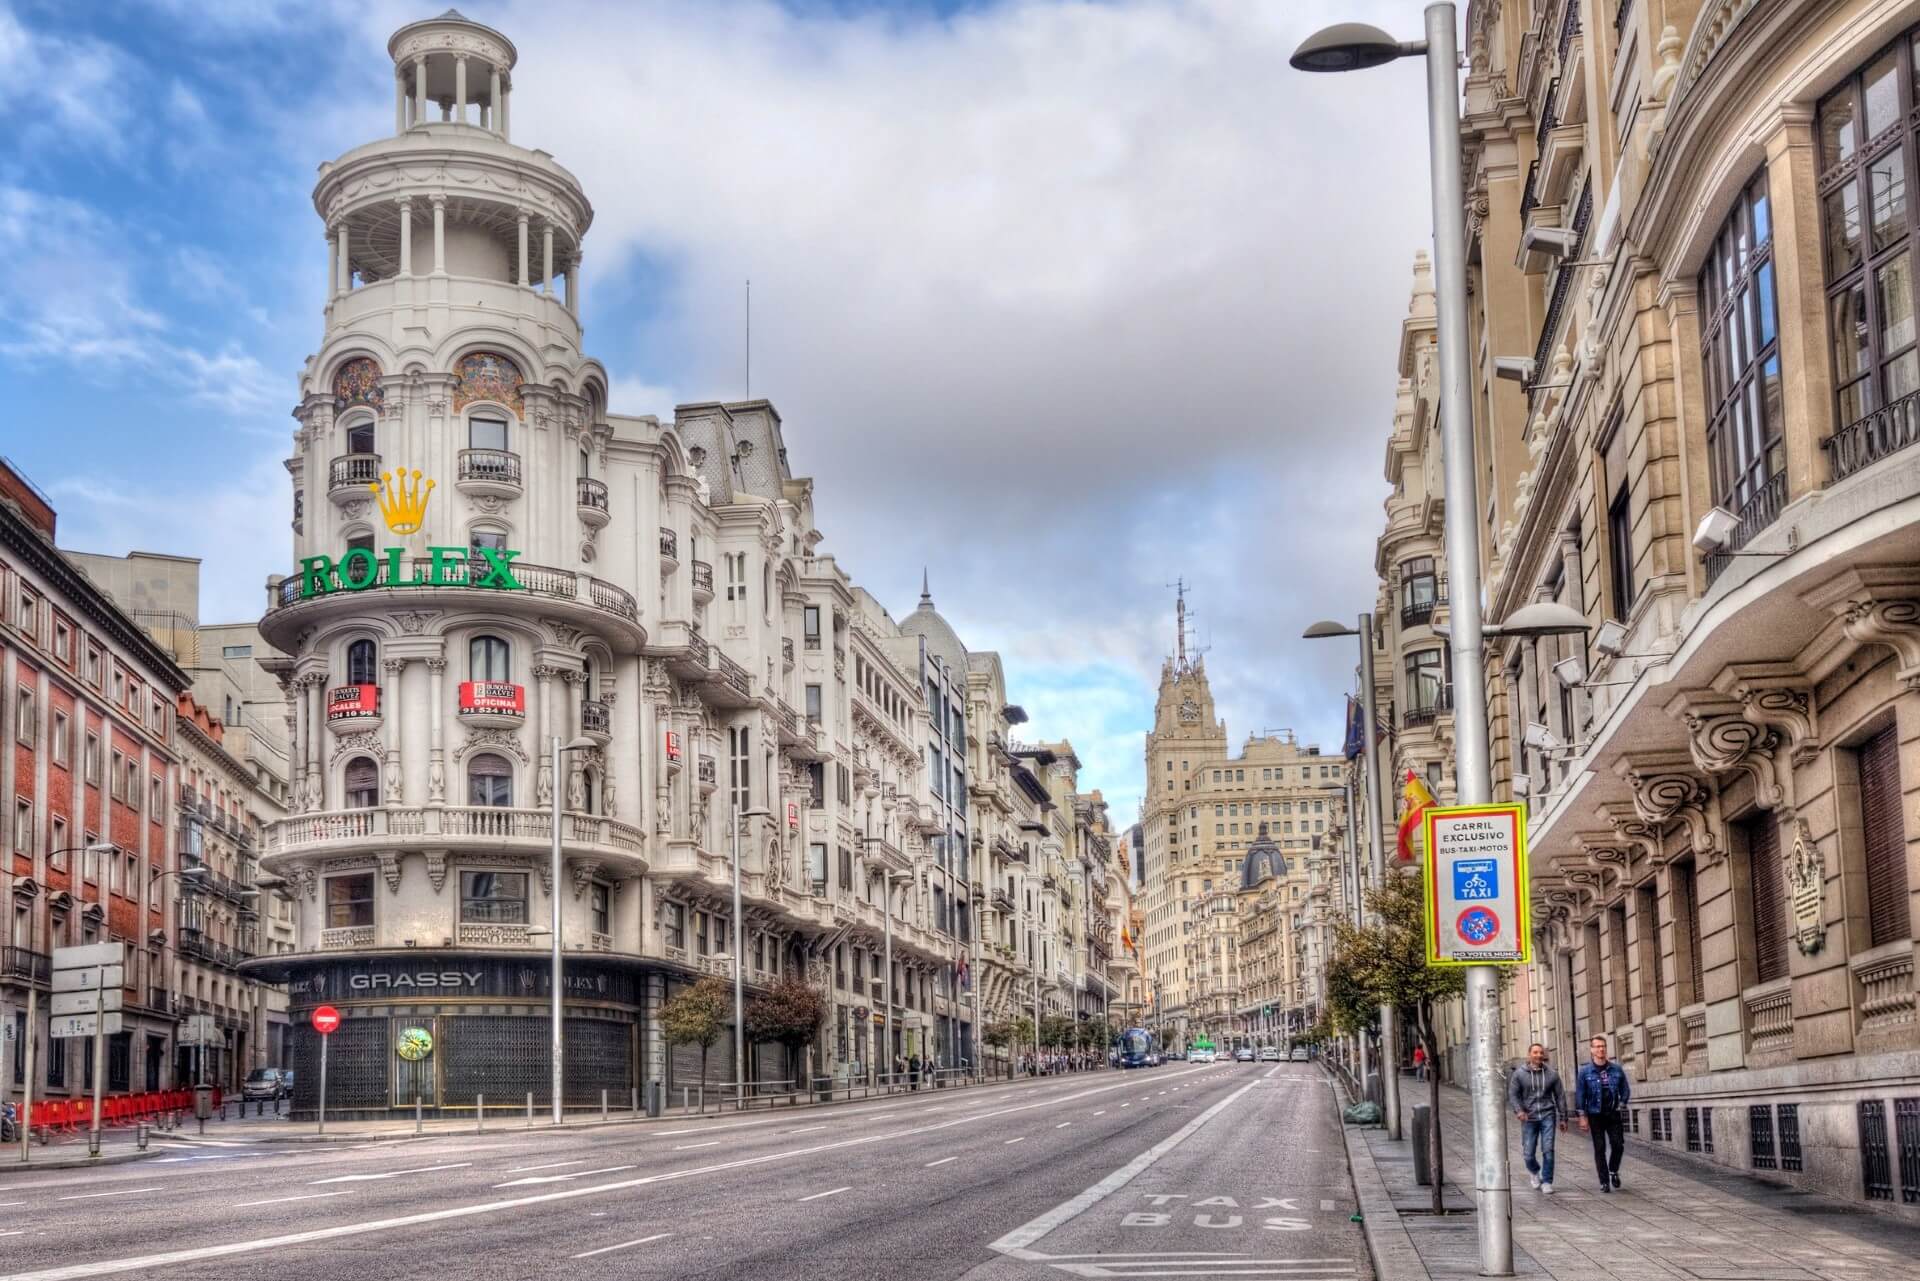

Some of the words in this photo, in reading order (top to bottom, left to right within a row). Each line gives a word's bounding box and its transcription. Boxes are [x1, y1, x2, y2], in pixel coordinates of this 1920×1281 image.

[299, 546, 525, 598] ROLEX
[474, 699, 516, 707] OFICINAS
[1453, 821, 1494, 831] CARRIL
[1443, 831, 1504, 843] EXCLUSIVO
[1461, 887, 1492, 898] TAXI
[350, 972, 483, 989] GRASSY
[1119, 1212, 1313, 1231] BUS
